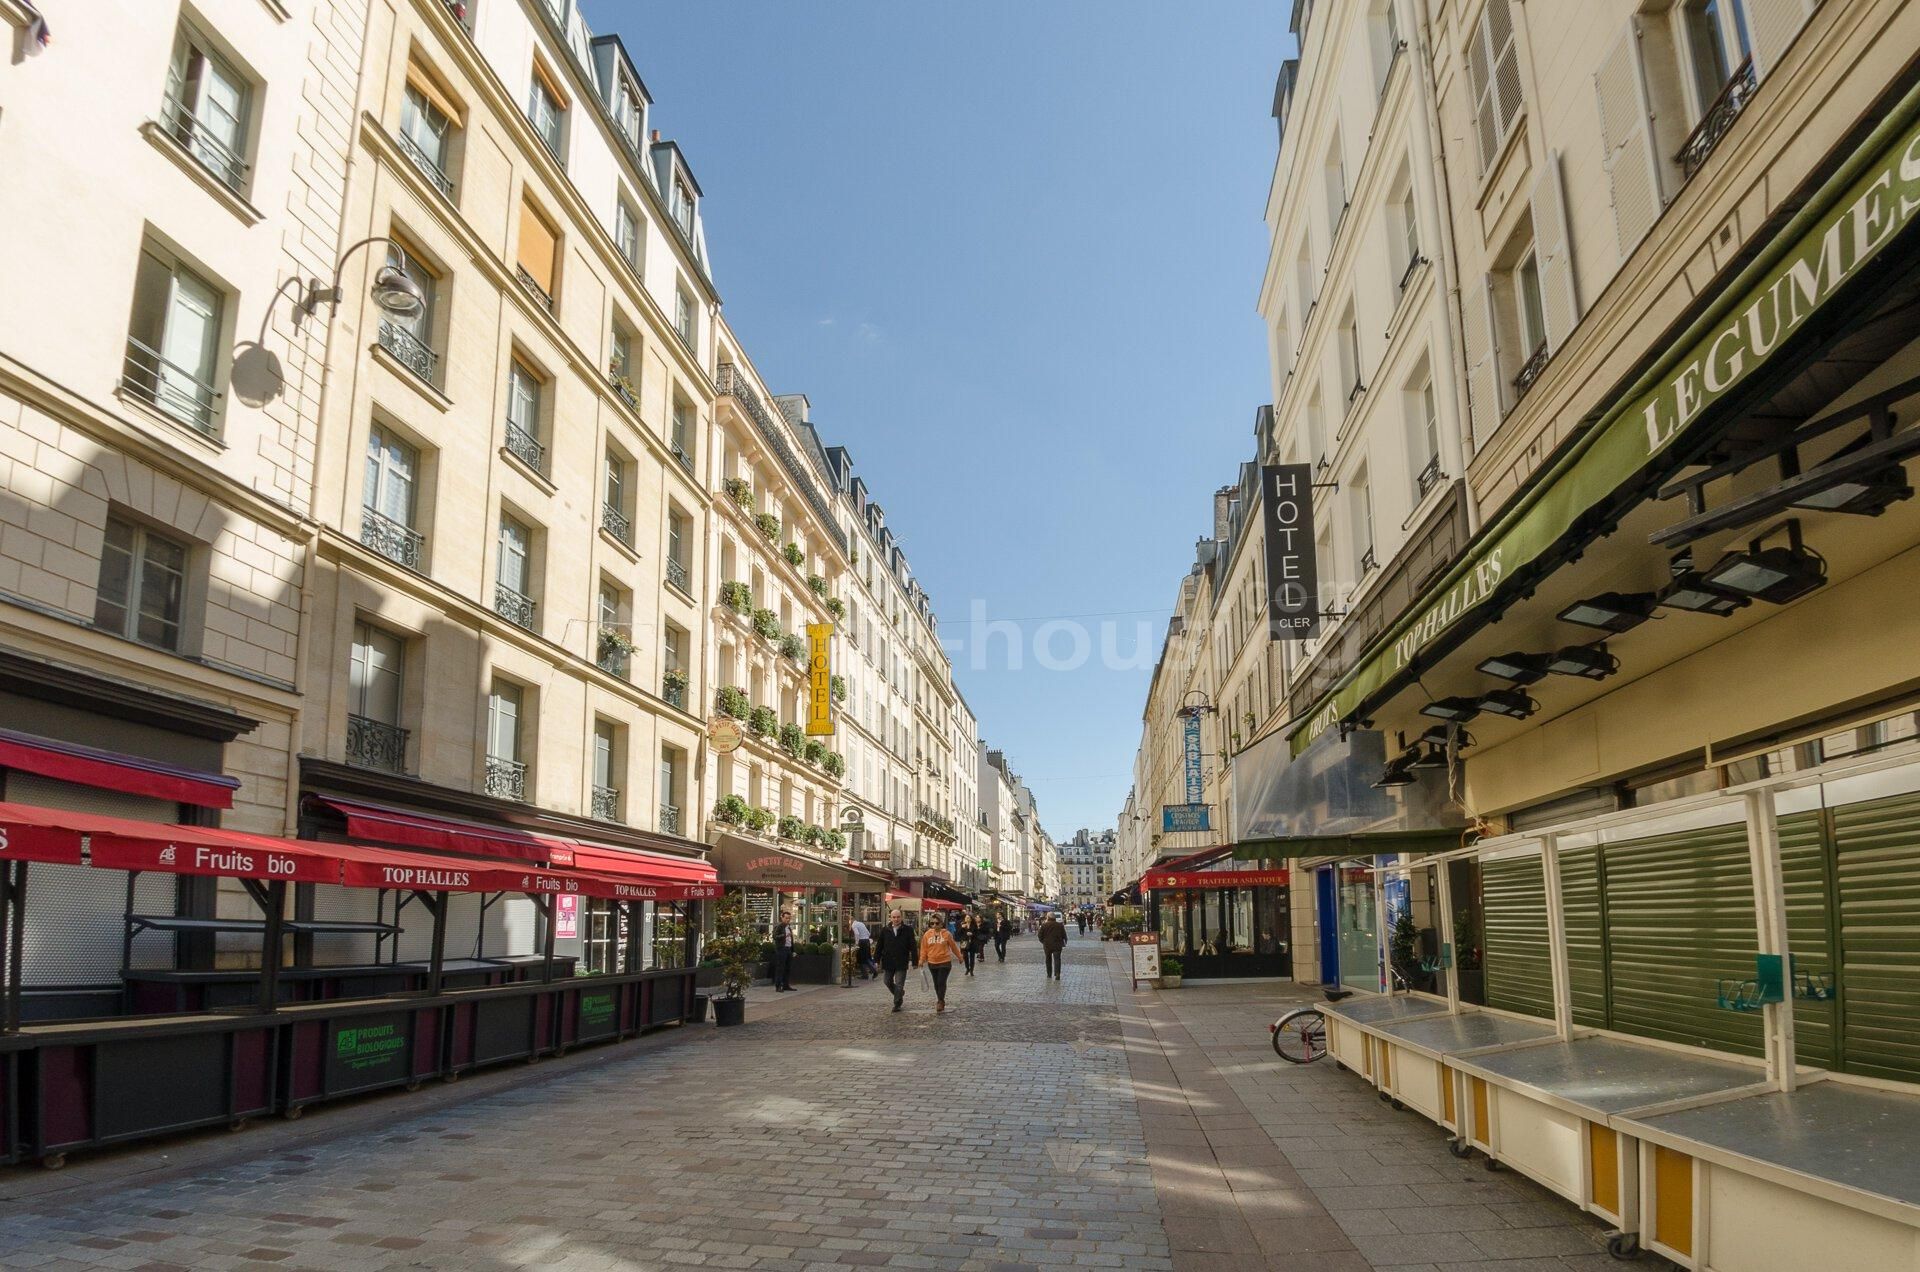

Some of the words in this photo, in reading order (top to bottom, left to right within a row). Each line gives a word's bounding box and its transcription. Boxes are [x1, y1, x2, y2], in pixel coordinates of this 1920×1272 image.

[1642, 133, 1920, 456] LEGUMES
[1275, 473, 1301, 607] HOTEL
[1395, 633, 1421, 670] TOP
[1421, 547, 1503, 645] HALLES
[1279, 617, 1311, 629] CLER
[813, 638, 828, 720] HOTEL
[1186, 734, 1201, 804] SABLAISE
[195, 847, 254, 871] Fruits
[267, 854, 296, 874] bio
[758, 856, 782, 867] PETIT
[383, 867, 413, 883] TOP
[416, 869, 470, 887] HALLES
[536, 876, 561, 891] Fruits
[566, 879, 579, 892] bio
[1240, 876, 1284, 885] ASIATIQUE
[615, 884, 631, 896] TOP
[630, 885, 657, 897] HALLES
[707, 886, 715, 896] bio
[357, 1025, 394, 1039] PRODUITS
[357, 1036, 406, 1055] BIOLOGIQUES
